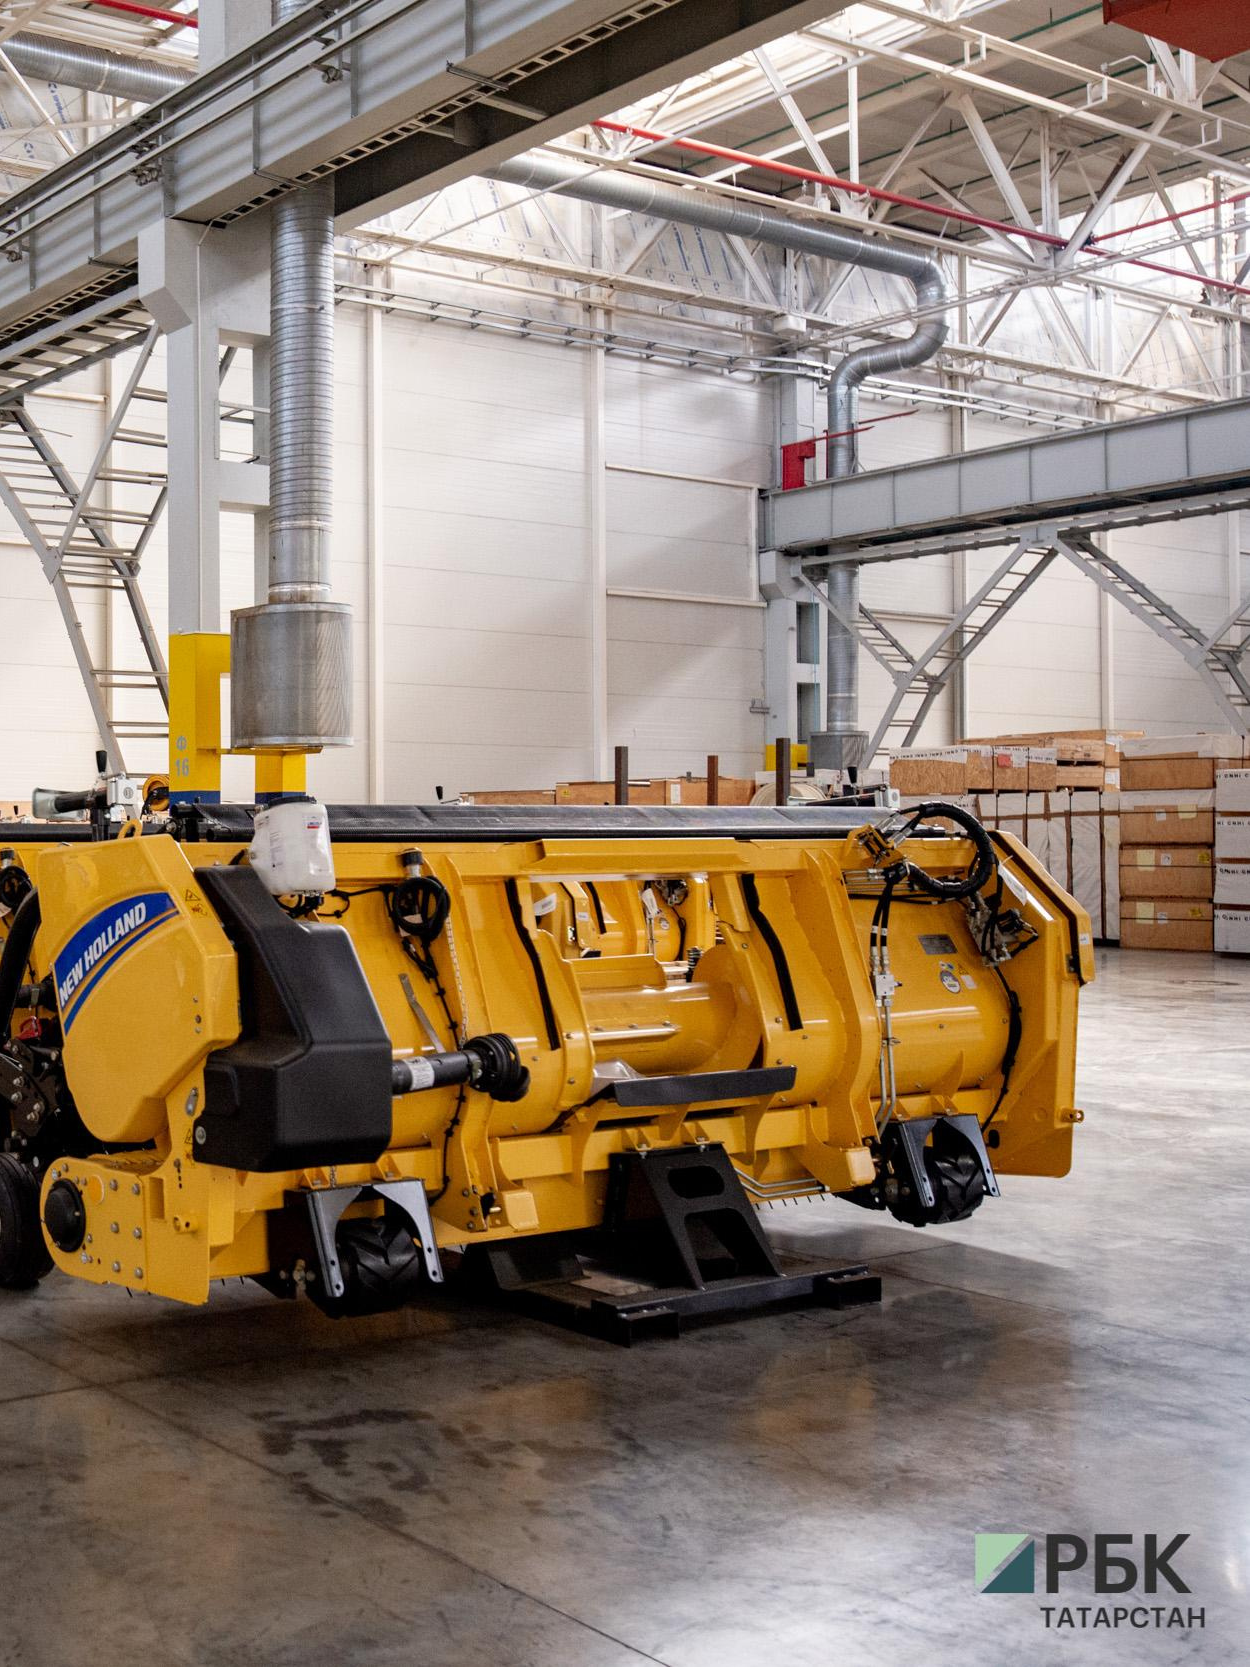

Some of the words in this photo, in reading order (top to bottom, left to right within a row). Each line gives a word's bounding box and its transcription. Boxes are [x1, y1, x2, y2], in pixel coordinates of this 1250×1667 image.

[175, 757, 190, 777] 16
[58, 958, 84, 1007] NEW
[83, 902, 147, 972] HOLLAND
